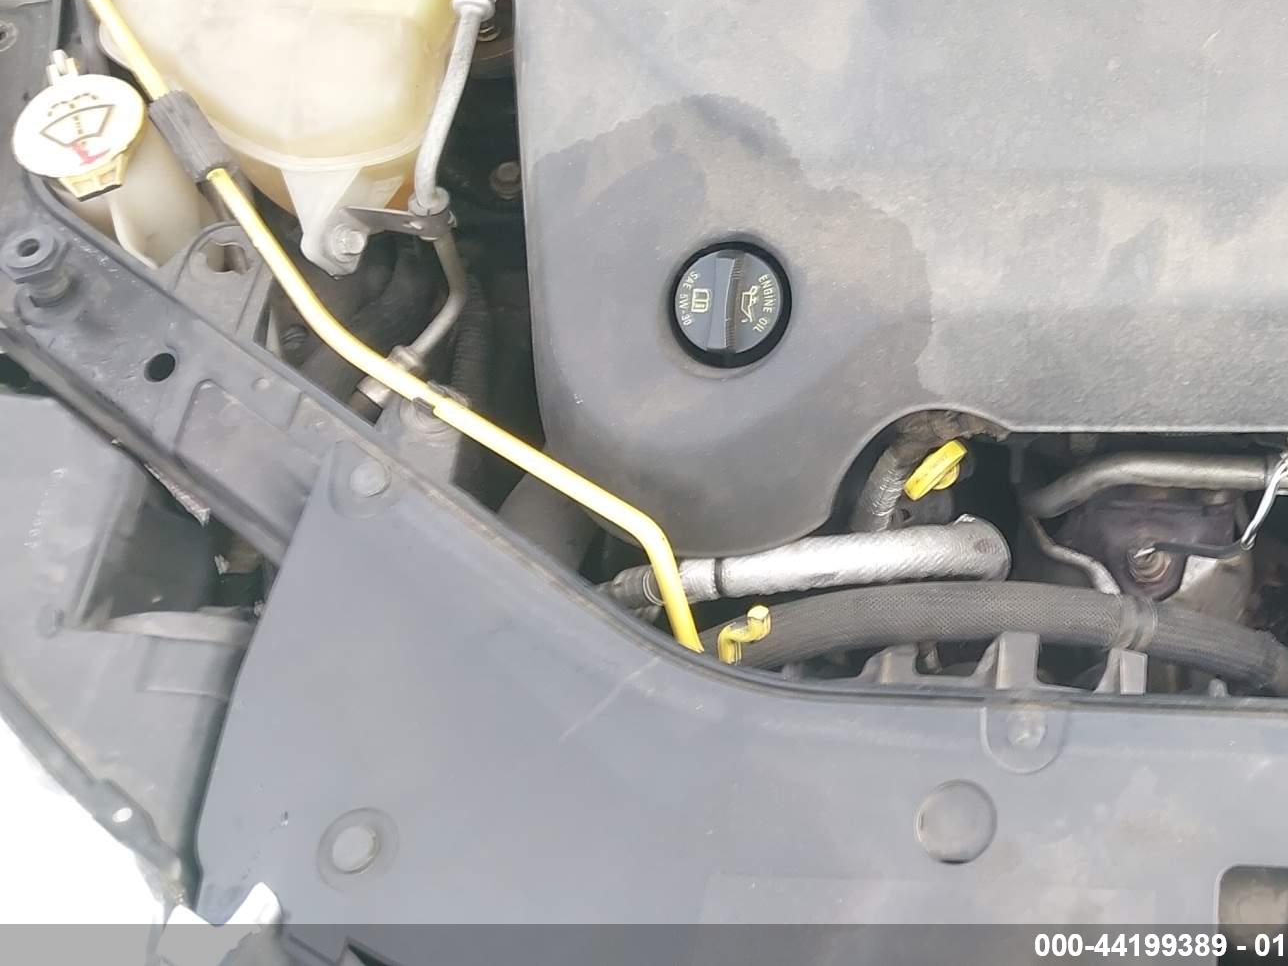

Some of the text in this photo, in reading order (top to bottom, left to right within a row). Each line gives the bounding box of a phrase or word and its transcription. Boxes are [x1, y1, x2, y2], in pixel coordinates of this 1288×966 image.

[679, 271, 698, 326] SAE 5W-30
[752, 273, 777, 332] ENGINE OIL
